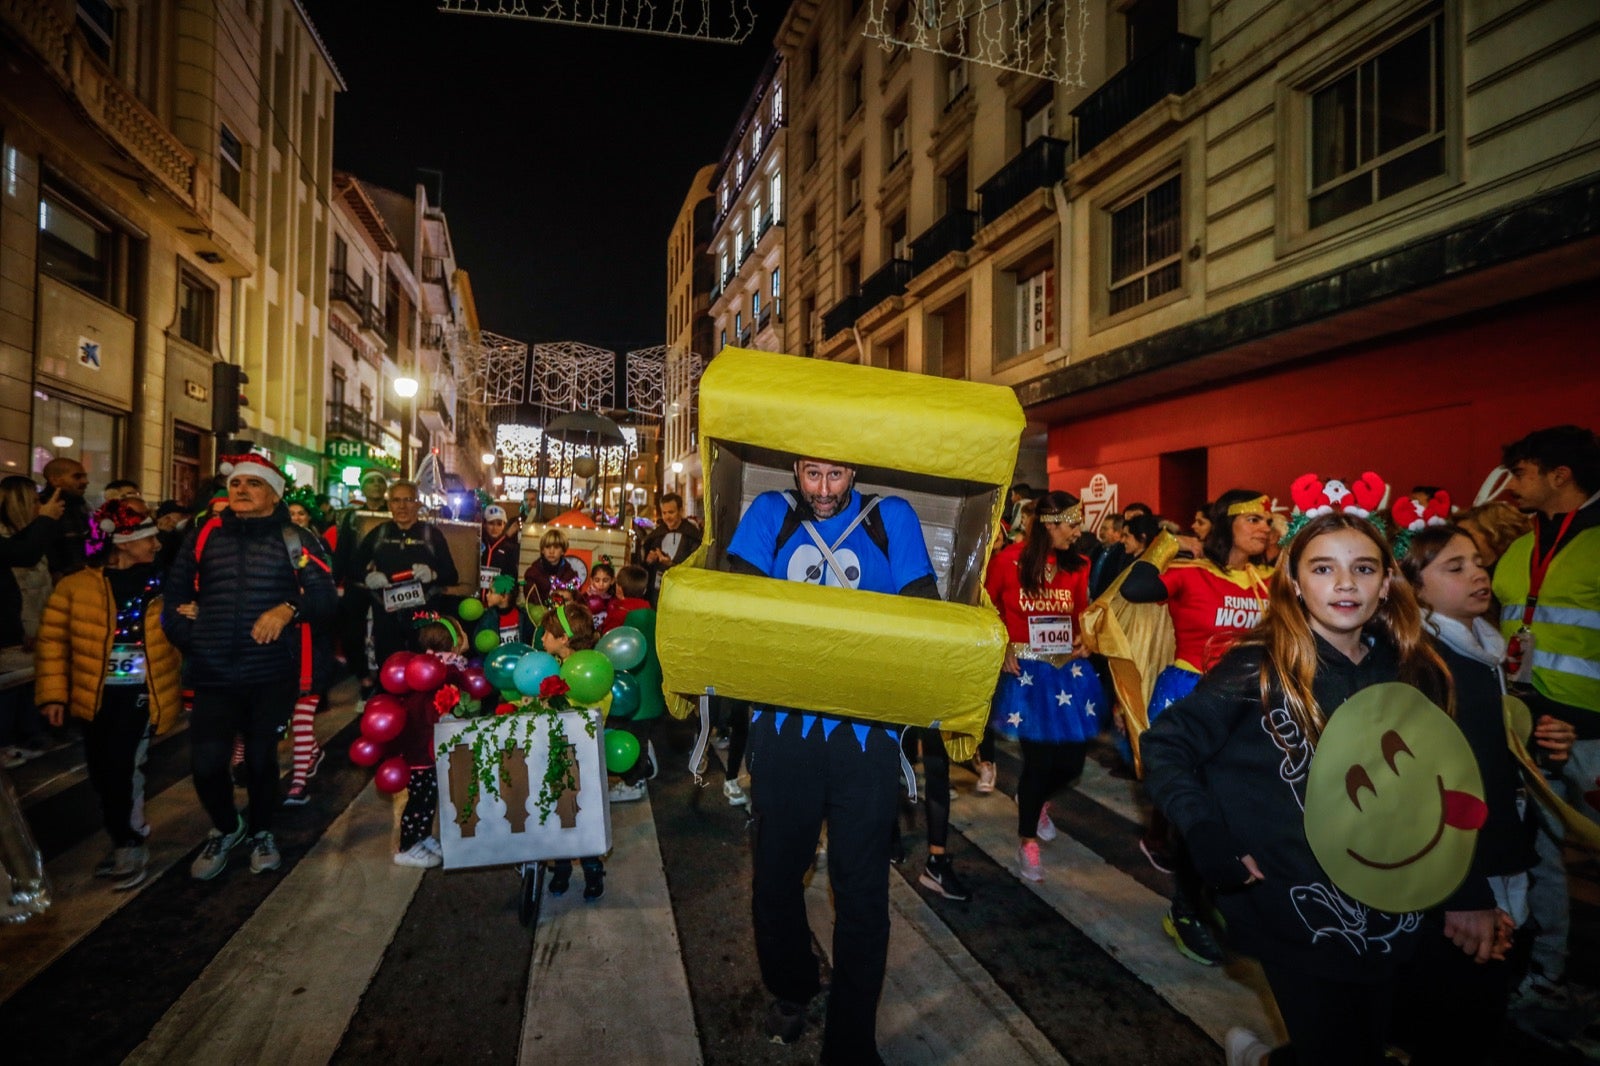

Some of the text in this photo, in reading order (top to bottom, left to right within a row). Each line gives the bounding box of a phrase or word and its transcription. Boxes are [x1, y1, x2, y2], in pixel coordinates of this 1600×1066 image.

[329, 442, 361, 456] 16H
[391, 589, 420, 603] 1098
[1038, 630, 1070, 644] 1040
